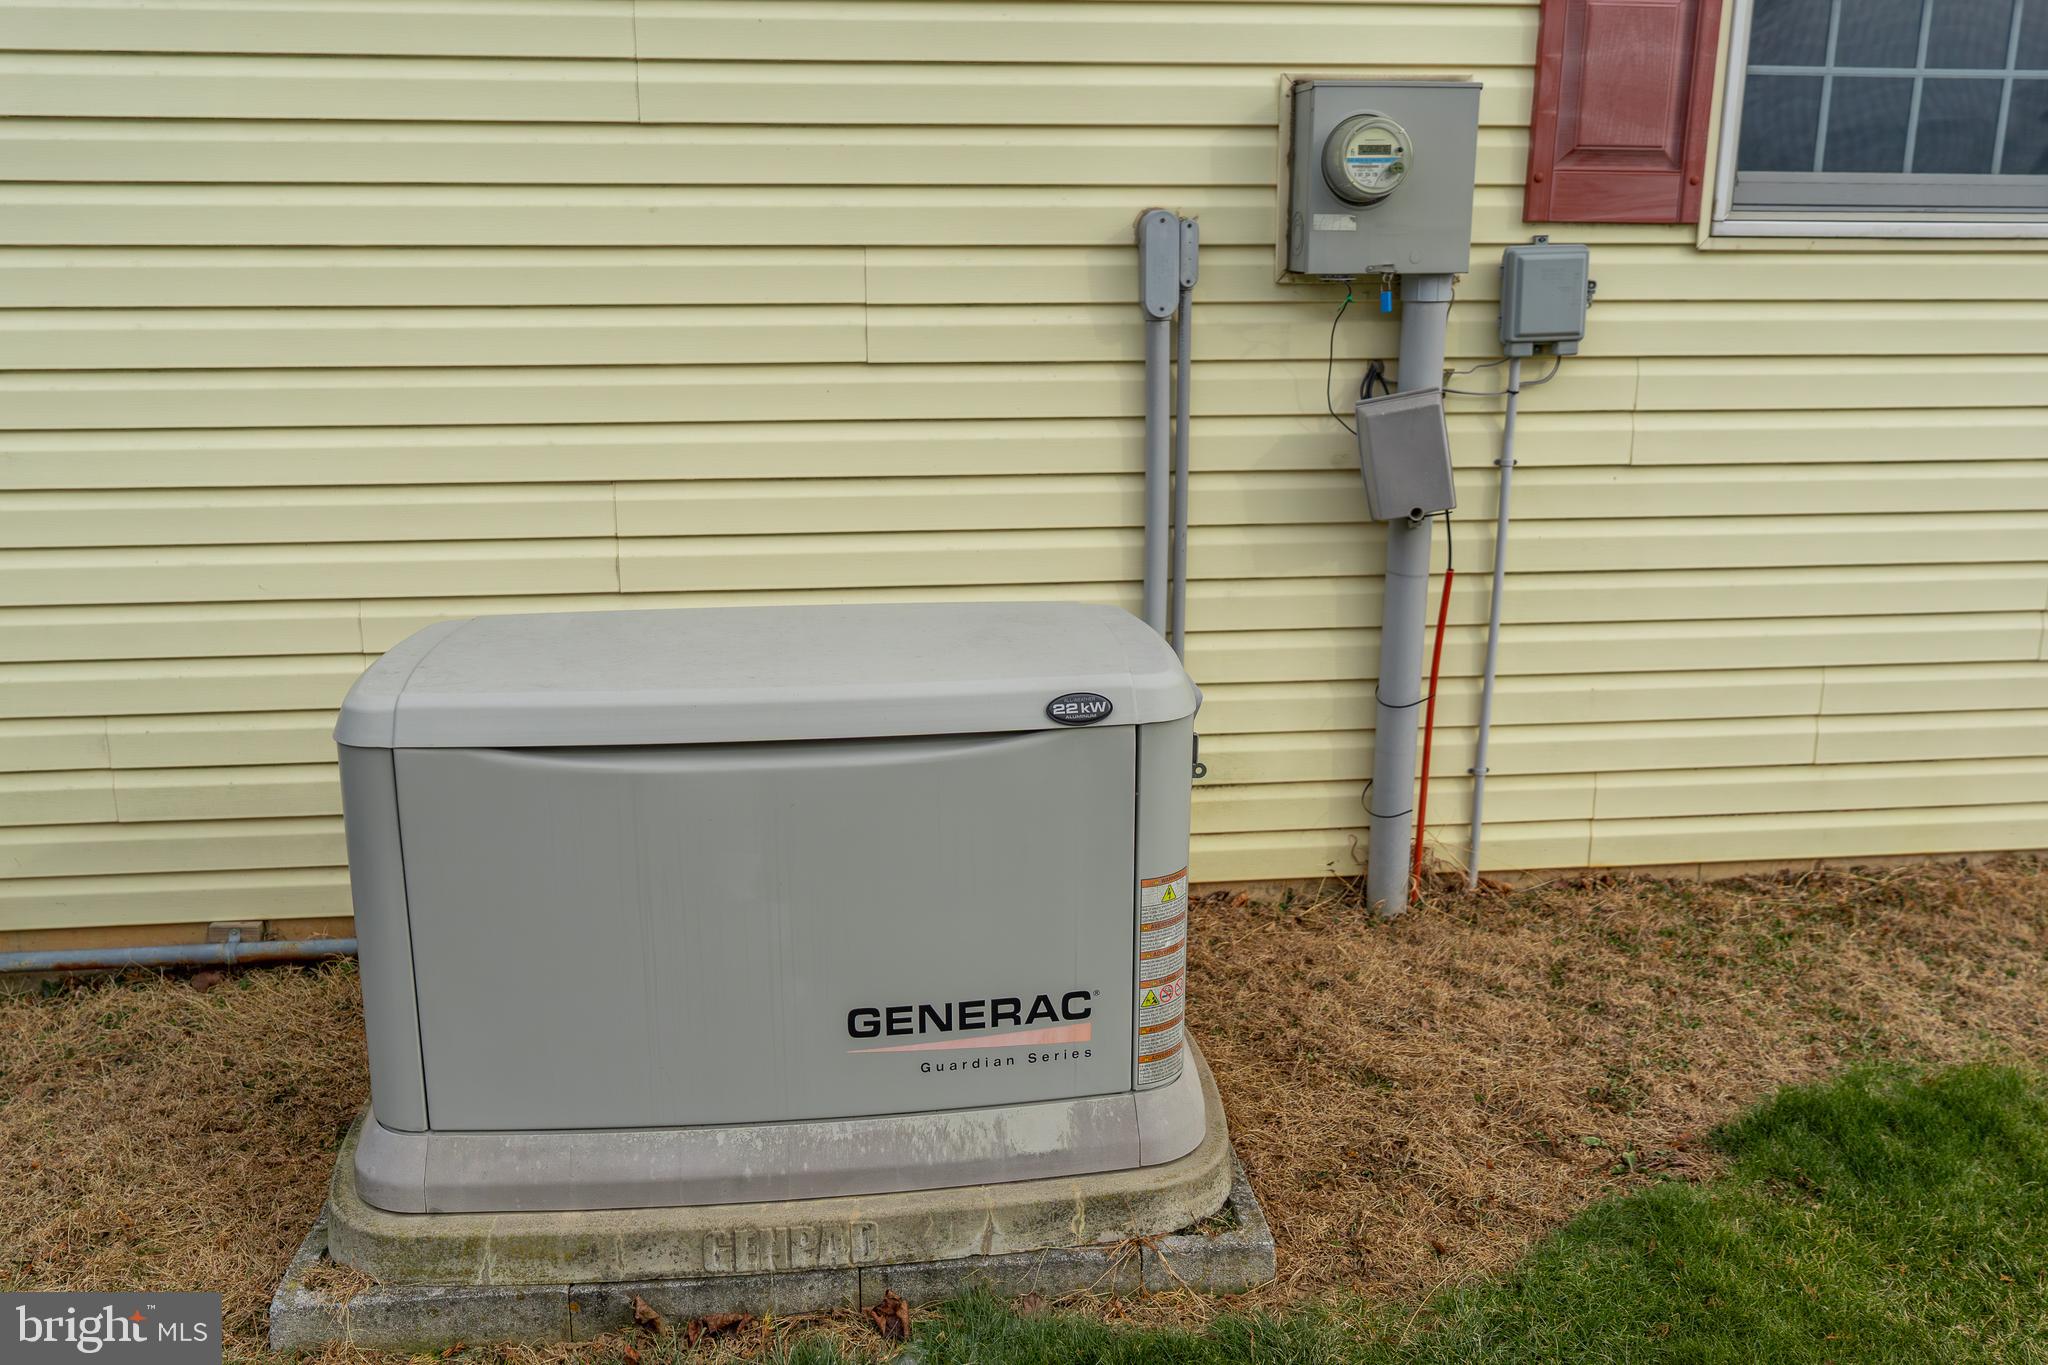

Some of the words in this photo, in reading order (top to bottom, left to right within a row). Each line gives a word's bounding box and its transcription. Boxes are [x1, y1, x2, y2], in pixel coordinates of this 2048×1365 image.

[1053, 703, 1078, 714] 22
[1081, 702, 1106, 713] kW
[920, 1057, 1015, 1073] Guardian
[1028, 1048, 1093, 1064] Series
